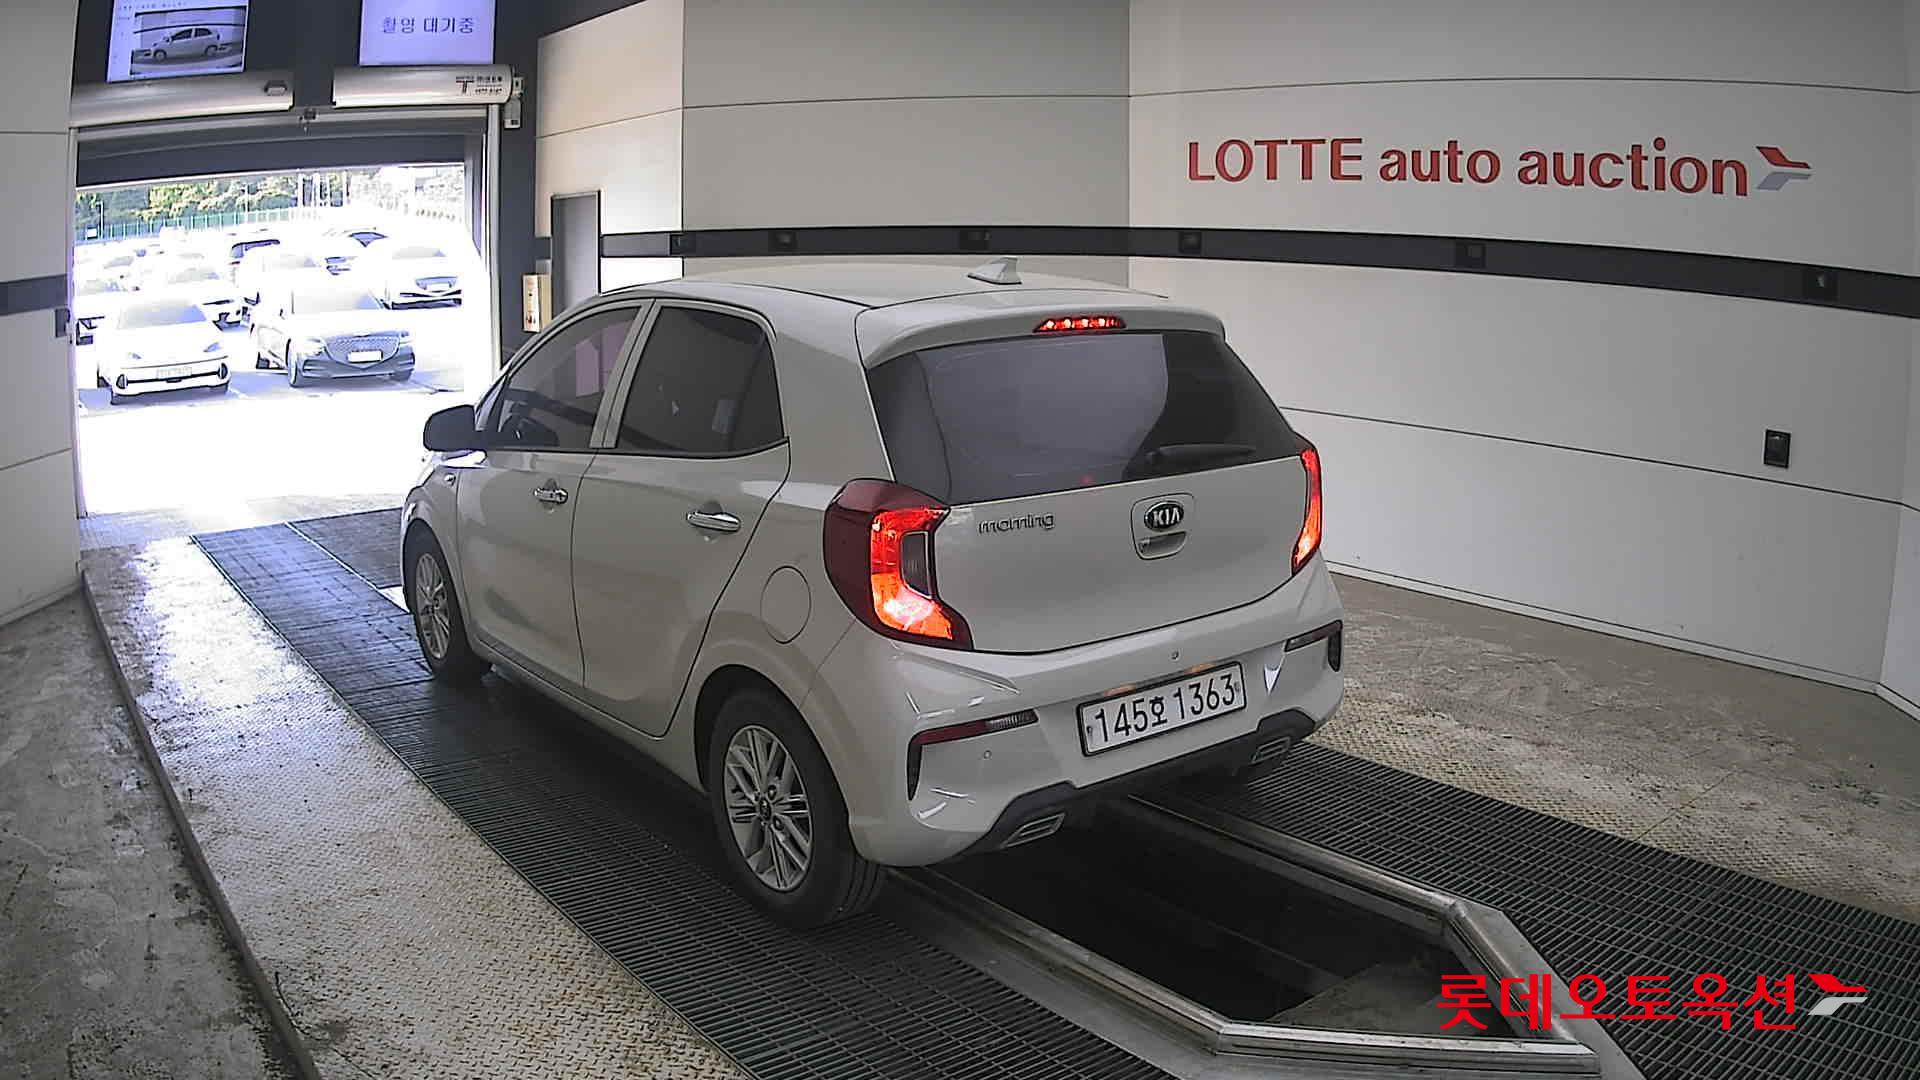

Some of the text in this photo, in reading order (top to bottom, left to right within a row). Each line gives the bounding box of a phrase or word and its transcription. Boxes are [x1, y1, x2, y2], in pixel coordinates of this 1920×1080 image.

[423, 17, 474, 34] 대기중
[1188, 137, 1748, 196] LOTTE auto auction
[978, 513, 1055, 534] morning
[1095, 673, 1235, 742] 145호 1363
